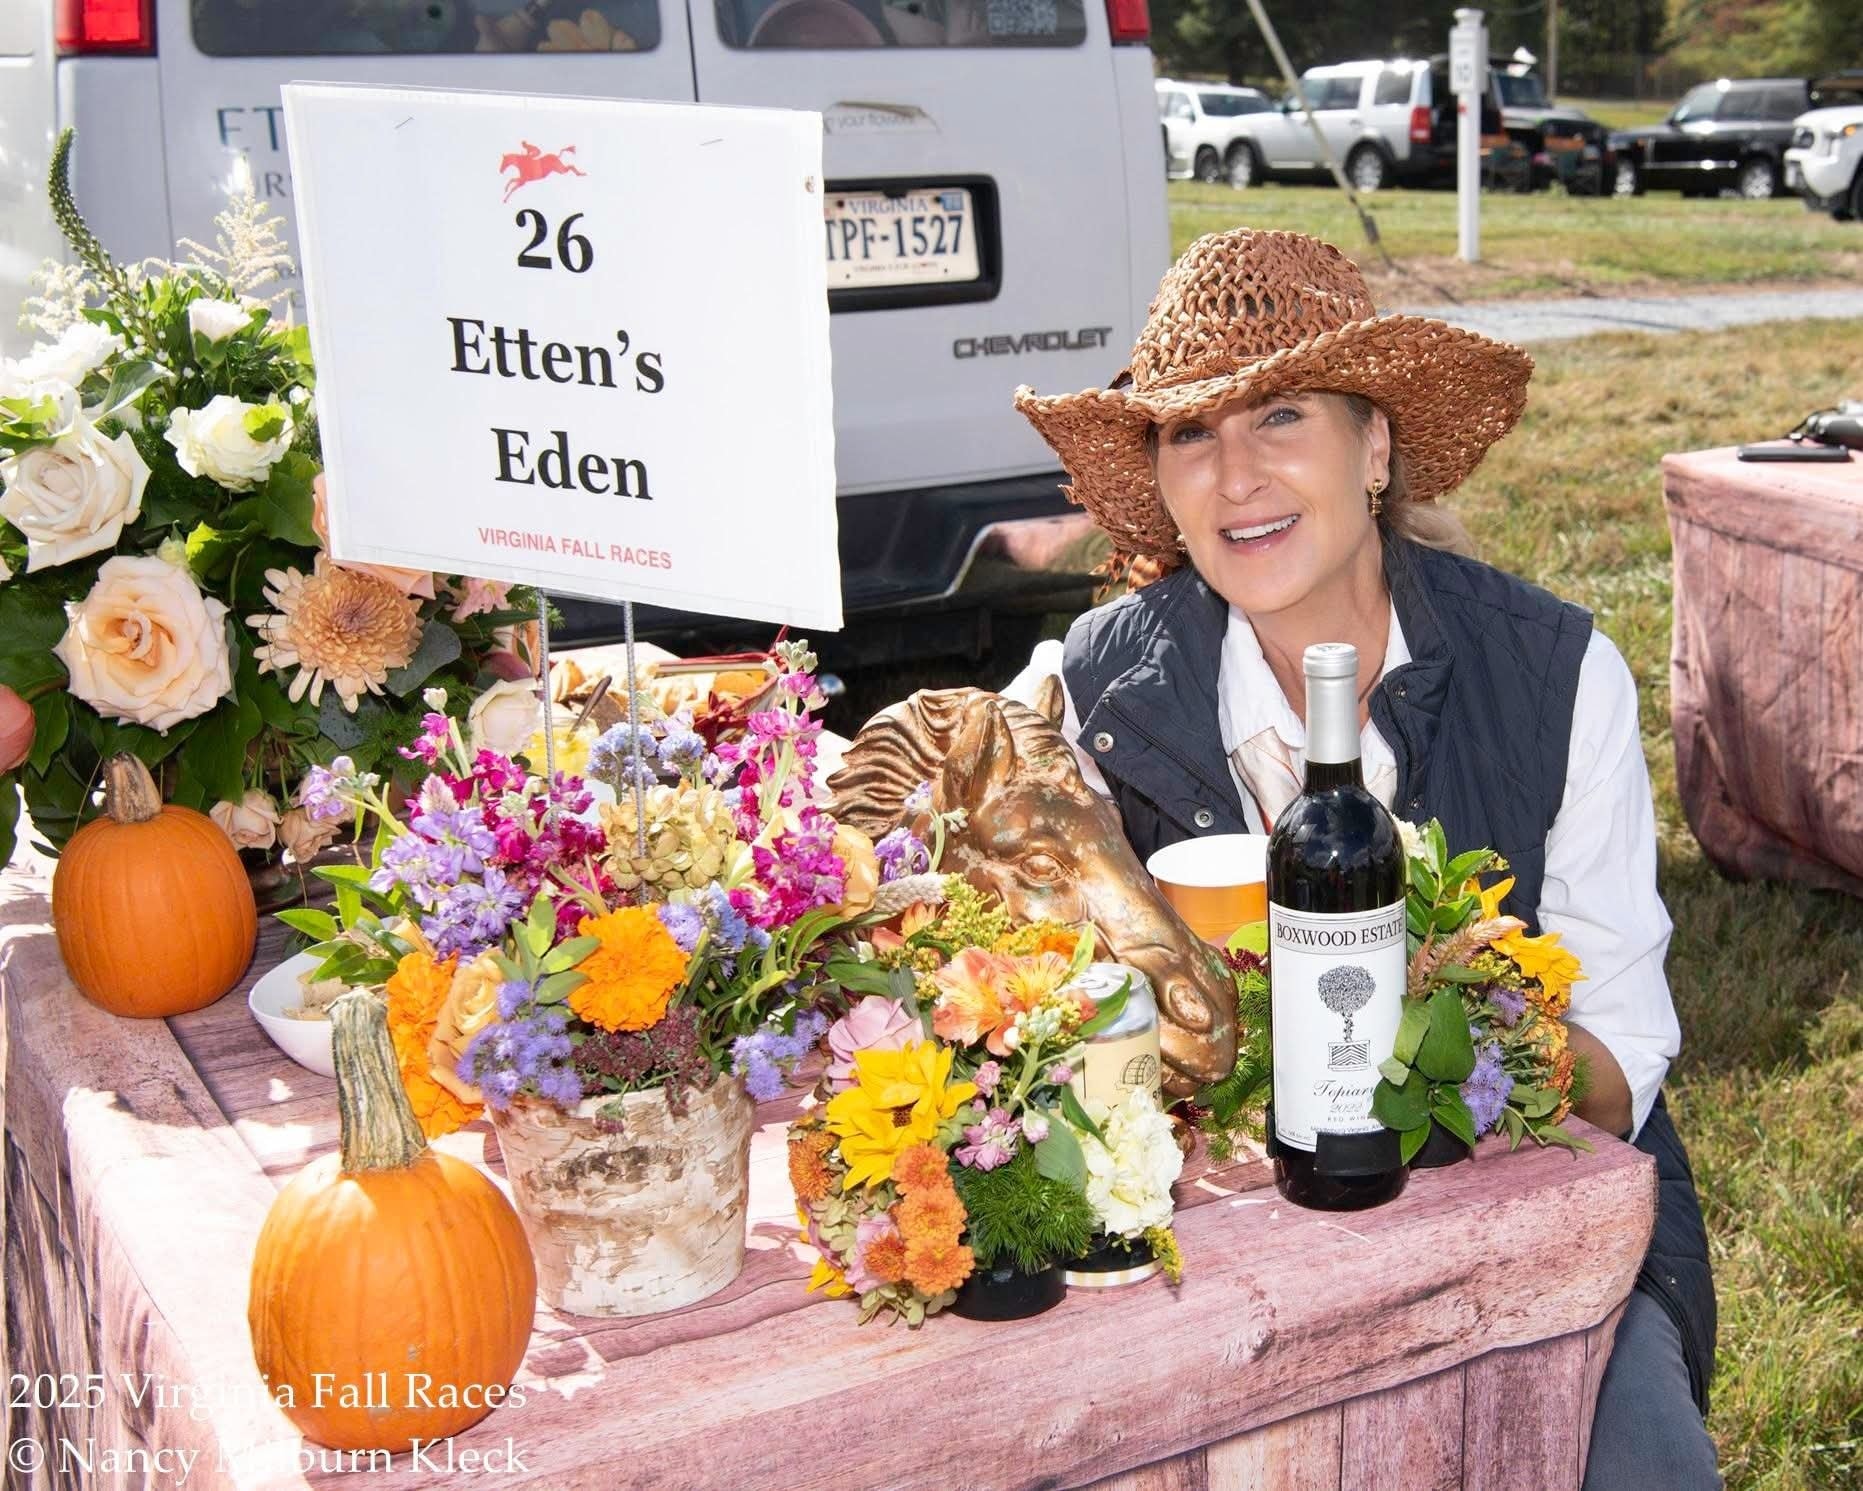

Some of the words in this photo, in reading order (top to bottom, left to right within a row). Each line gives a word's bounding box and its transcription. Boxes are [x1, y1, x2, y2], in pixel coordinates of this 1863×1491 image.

[849, 198, 929, 215] VIRGINIA
[515, 208, 594, 274] 26
[825, 214, 963, 261] TPF-1527
[953, 326, 1113, 359] CHEVROLET
[490, 427, 654, 501] Eden
[478, 527, 557, 553] VIRGINIA
[561, 537, 606, 561] FALL
[610, 544, 673, 570] RACES
[1277, 922, 1357, 947] BOXWOOD
[1360, 915, 1403, 945] ESTATE
